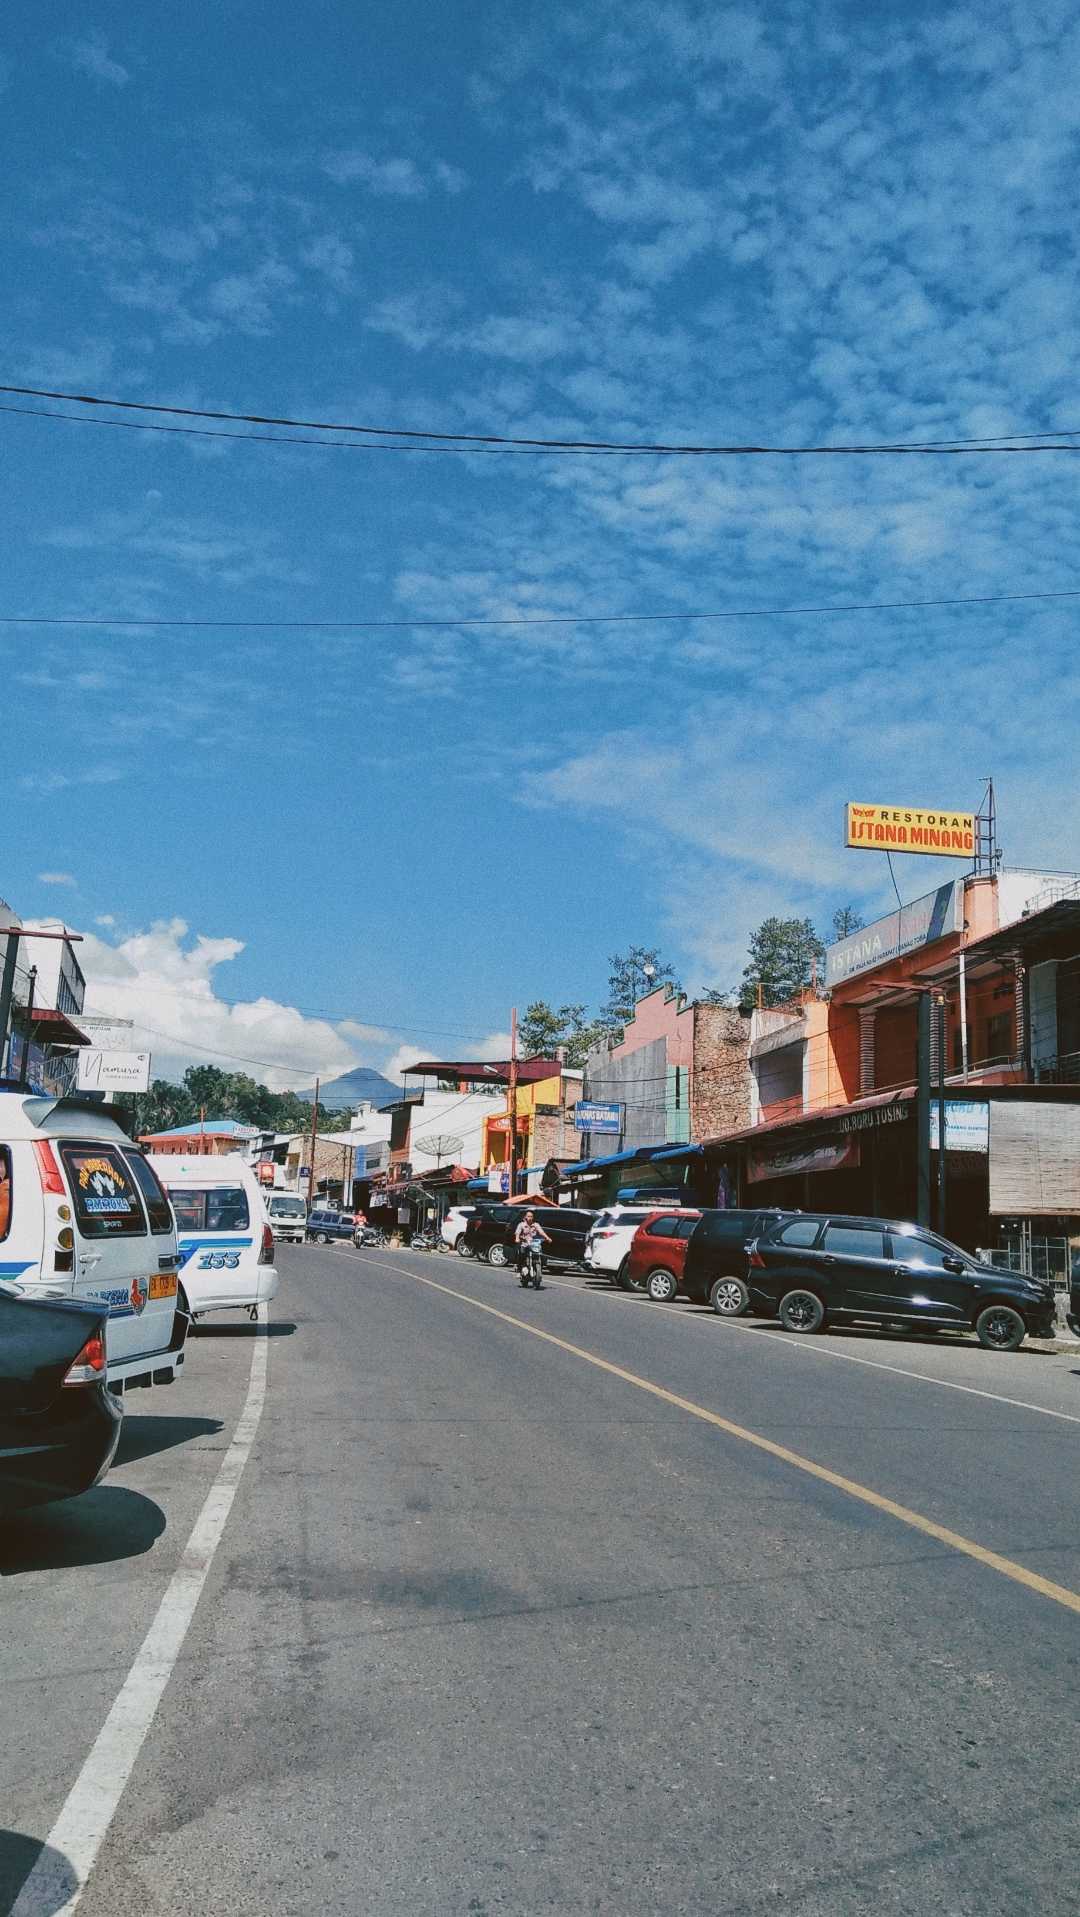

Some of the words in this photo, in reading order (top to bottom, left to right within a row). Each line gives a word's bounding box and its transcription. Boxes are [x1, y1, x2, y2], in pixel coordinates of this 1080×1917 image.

[881, 811, 972, 828] RESTORAN
[851, 821, 907, 843] ISTANA
[911, 827, 973, 849] MINANG
[831, 936, 881, 971] ISTANA
